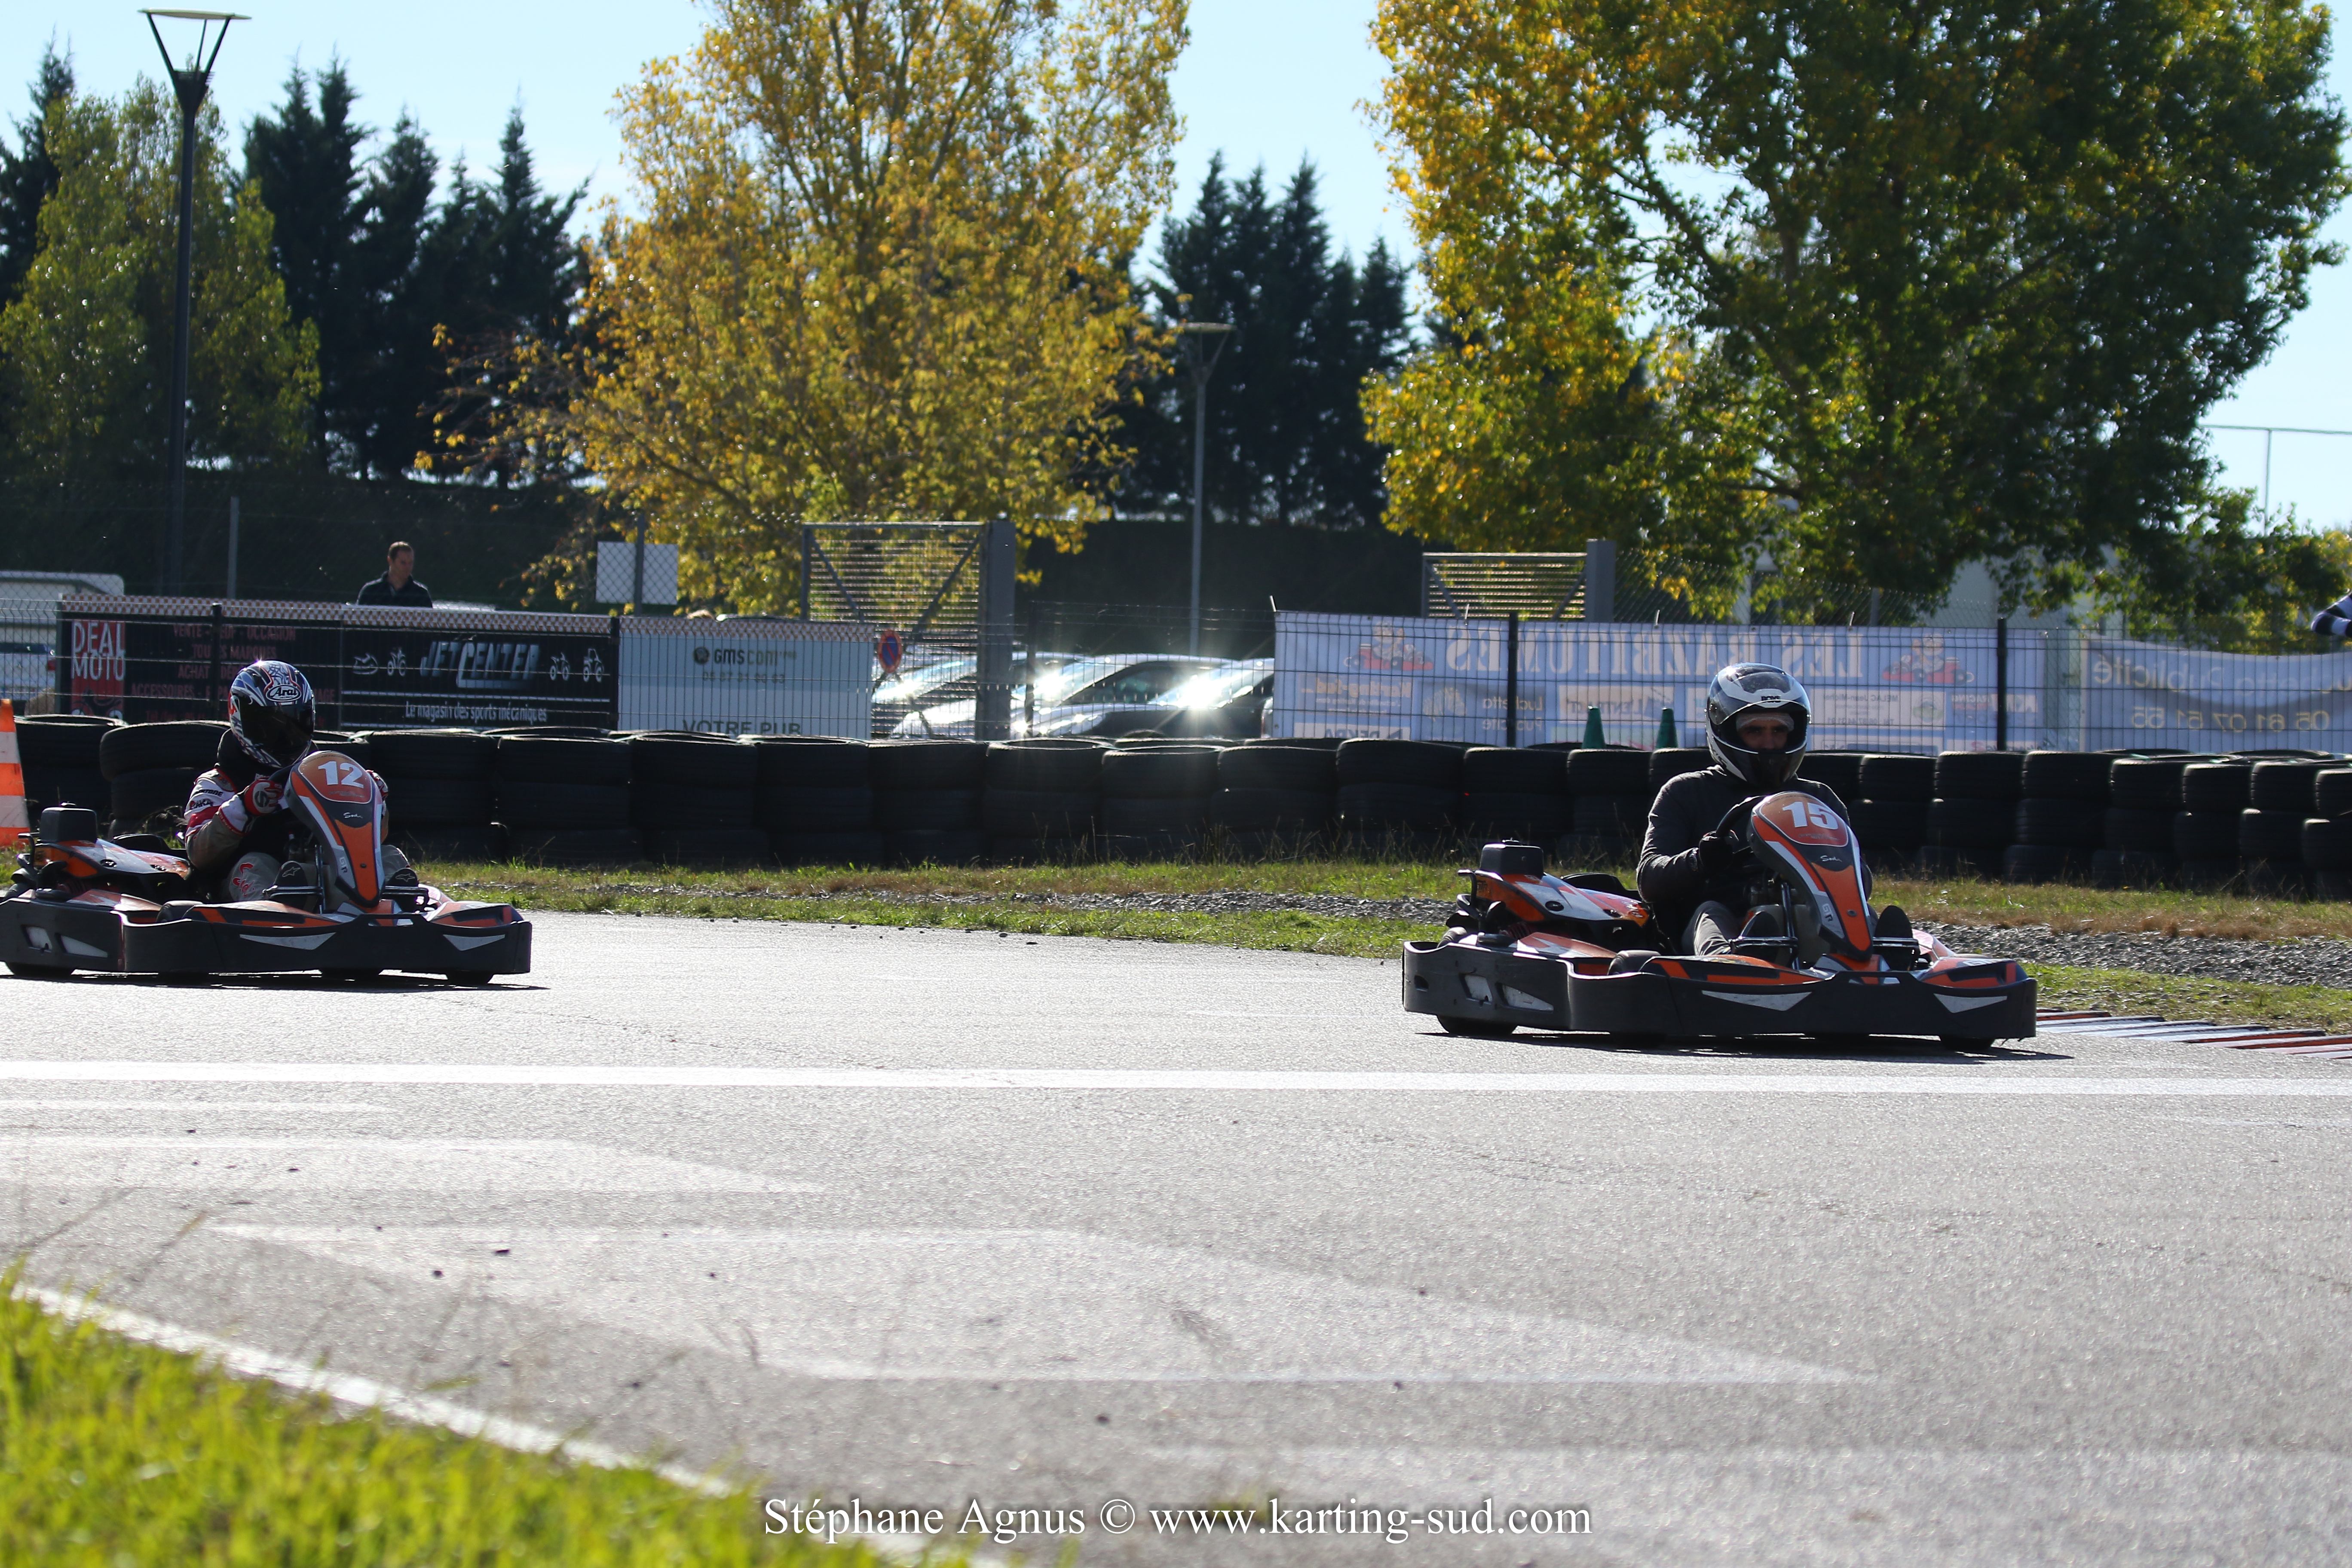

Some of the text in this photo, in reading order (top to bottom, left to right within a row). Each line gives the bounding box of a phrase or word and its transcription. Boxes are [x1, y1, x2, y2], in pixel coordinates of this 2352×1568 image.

[71, 621, 126, 657] DEAL
[173, 625, 202, 637] VENTE
[247, 626, 296, 640] OCCASION
[70, 649, 126, 681] MOTO
[177, 664, 210, 679] ACHAT
[270, 687, 297, 697] Arai
[417, 701, 453, 723] magasin
[454, 701, 469, 720] des
[470, 703, 497, 724] sports
[498, 701, 548, 726] mécaniques
[683, 720, 752, 734] VOTRE
[318, 760, 364, 789] 12
[1782, 801, 1839, 830] 15
